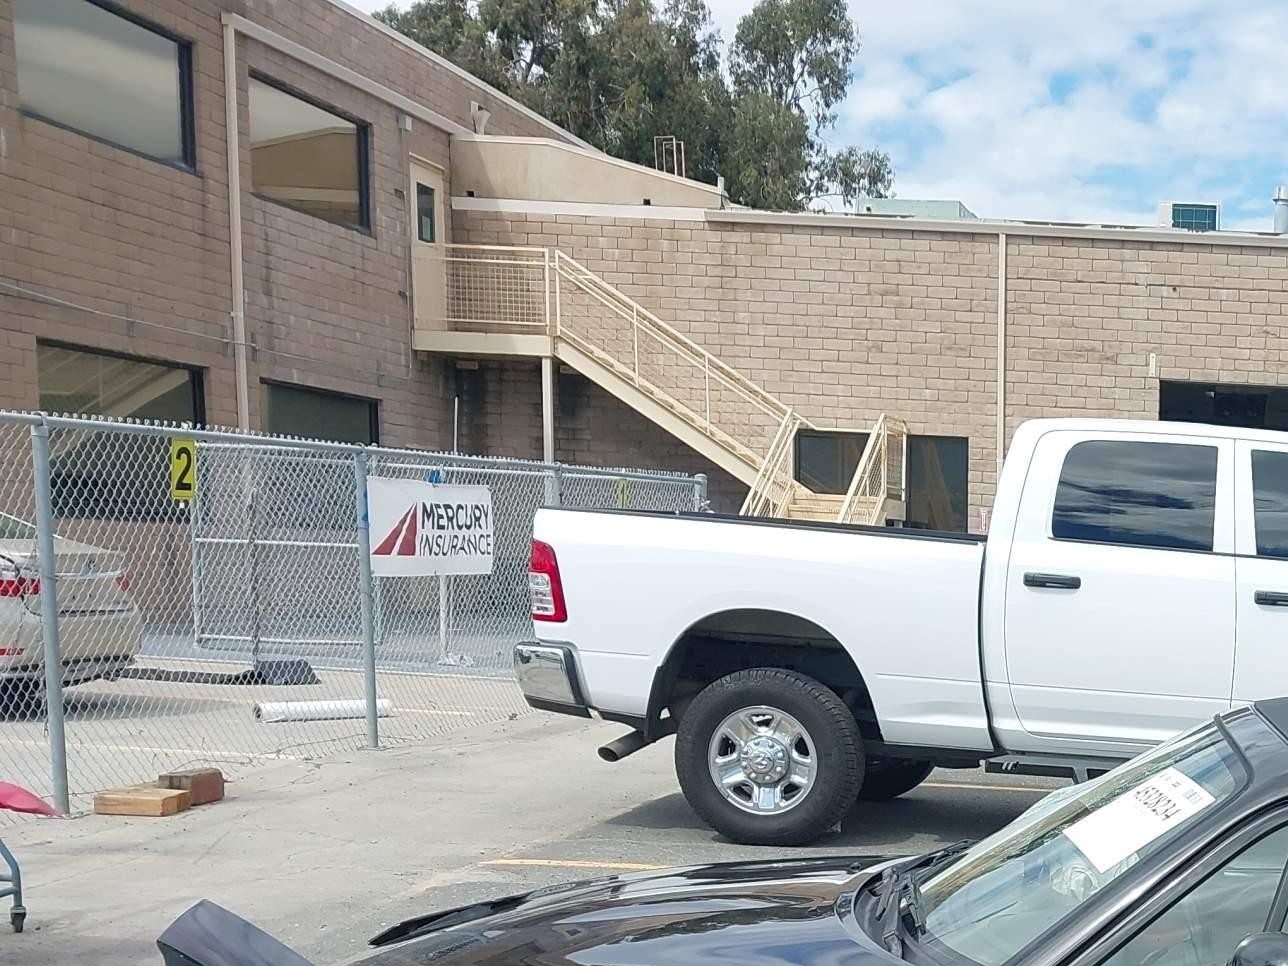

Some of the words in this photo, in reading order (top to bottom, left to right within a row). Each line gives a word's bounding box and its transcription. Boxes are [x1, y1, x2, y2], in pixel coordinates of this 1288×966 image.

[175, 446, 192, 491] 2
[421, 501, 489, 531] MERCURY
[419, 533, 492, 557] INSURANCE
